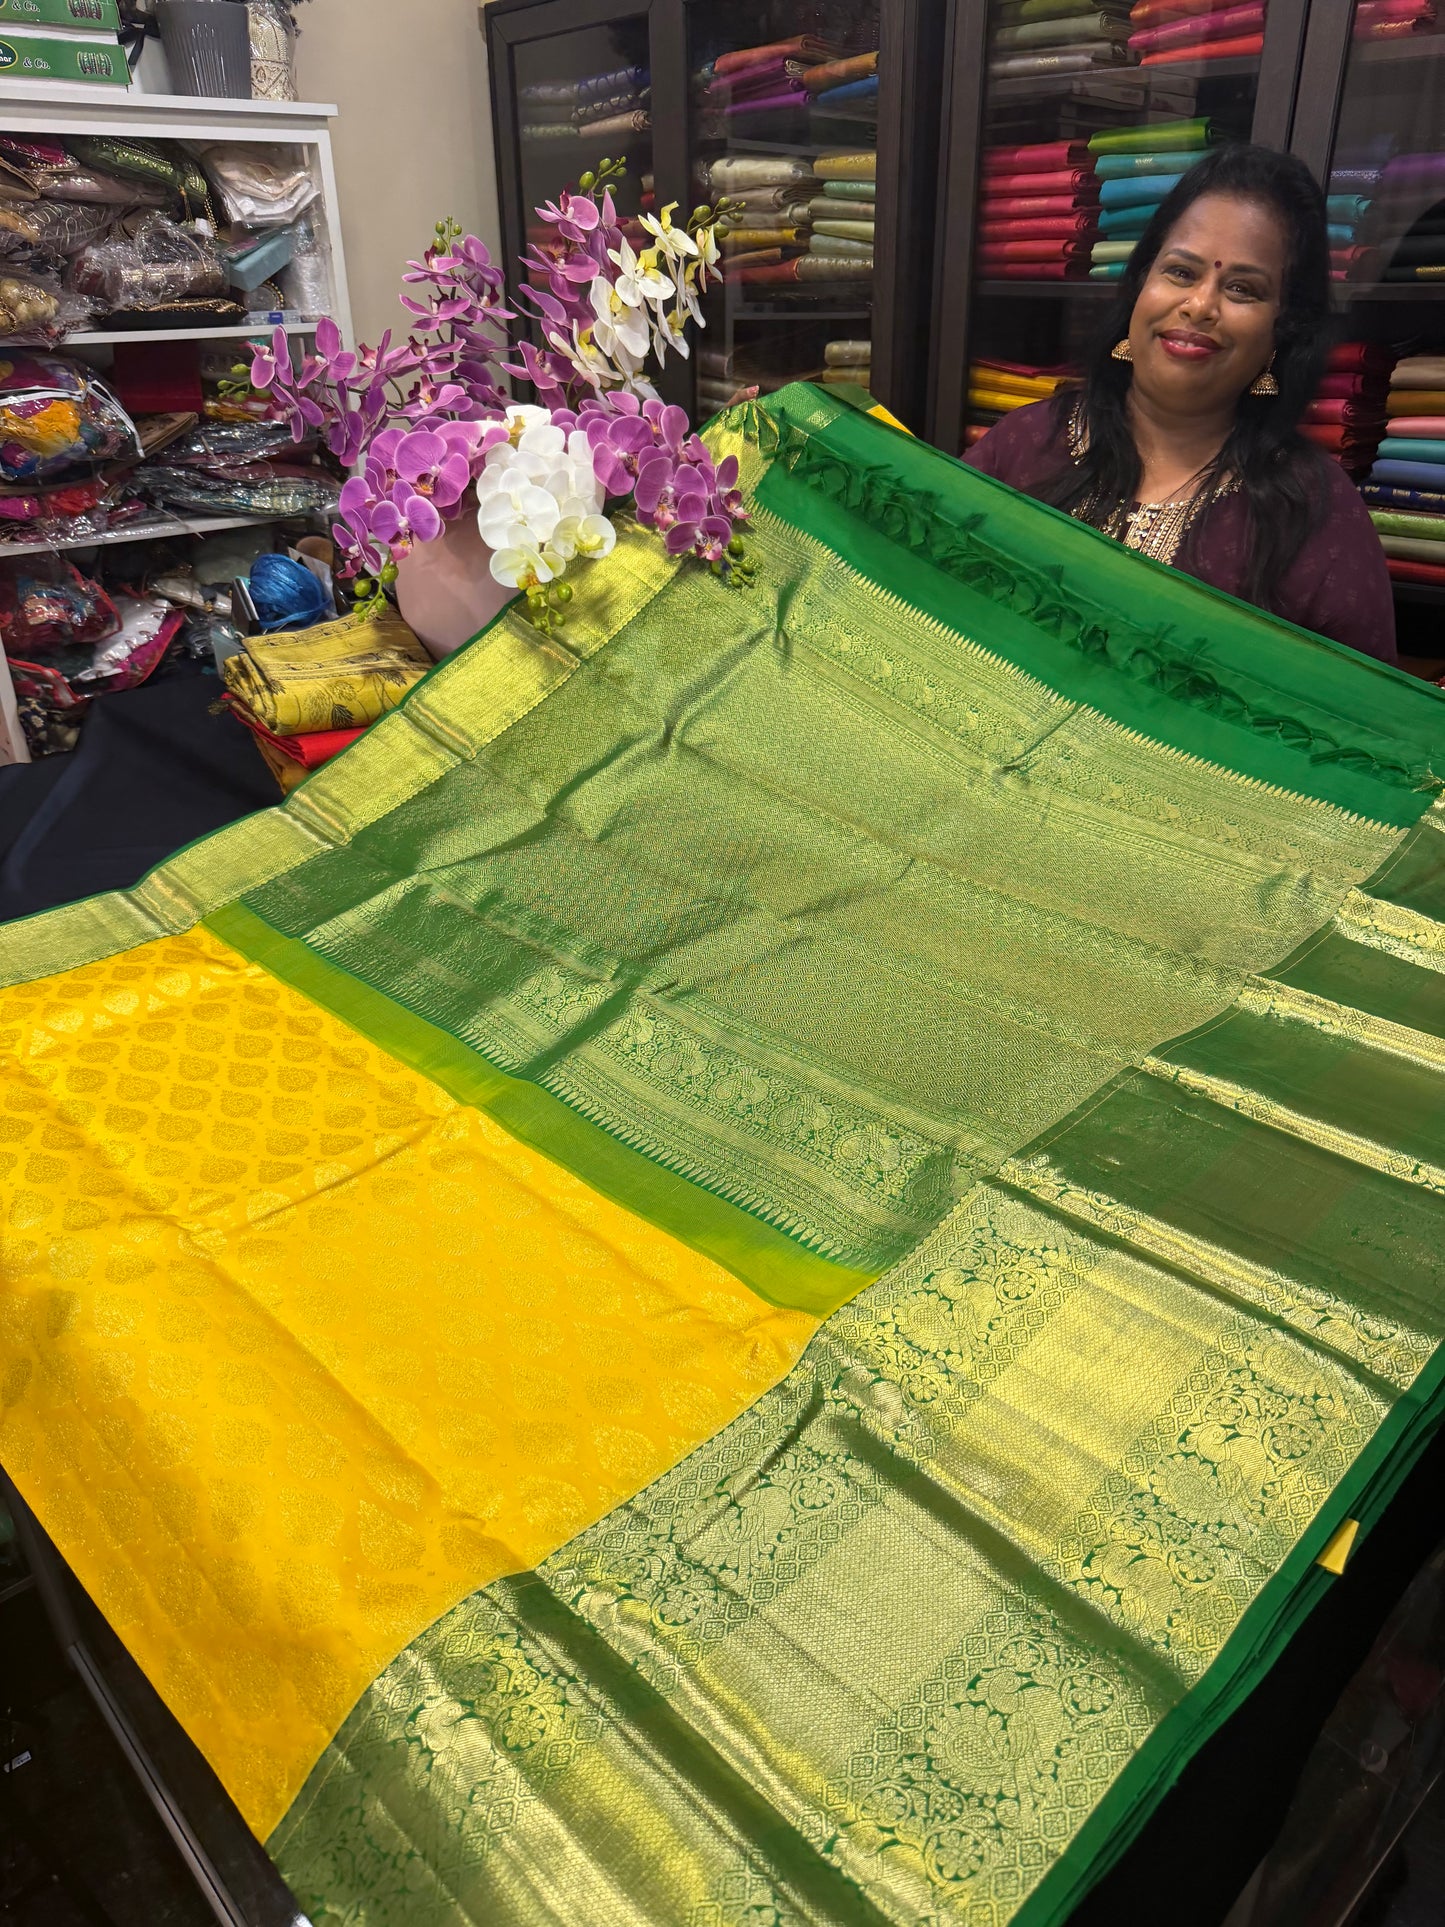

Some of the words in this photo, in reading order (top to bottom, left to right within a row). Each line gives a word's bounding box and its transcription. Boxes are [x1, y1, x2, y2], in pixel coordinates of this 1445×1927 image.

[12, 0, 21, 10] &
[23, 0, 40, 12] Co.
[23, 56, 32, 68] &
[34, 57, 50, 70] Co.
